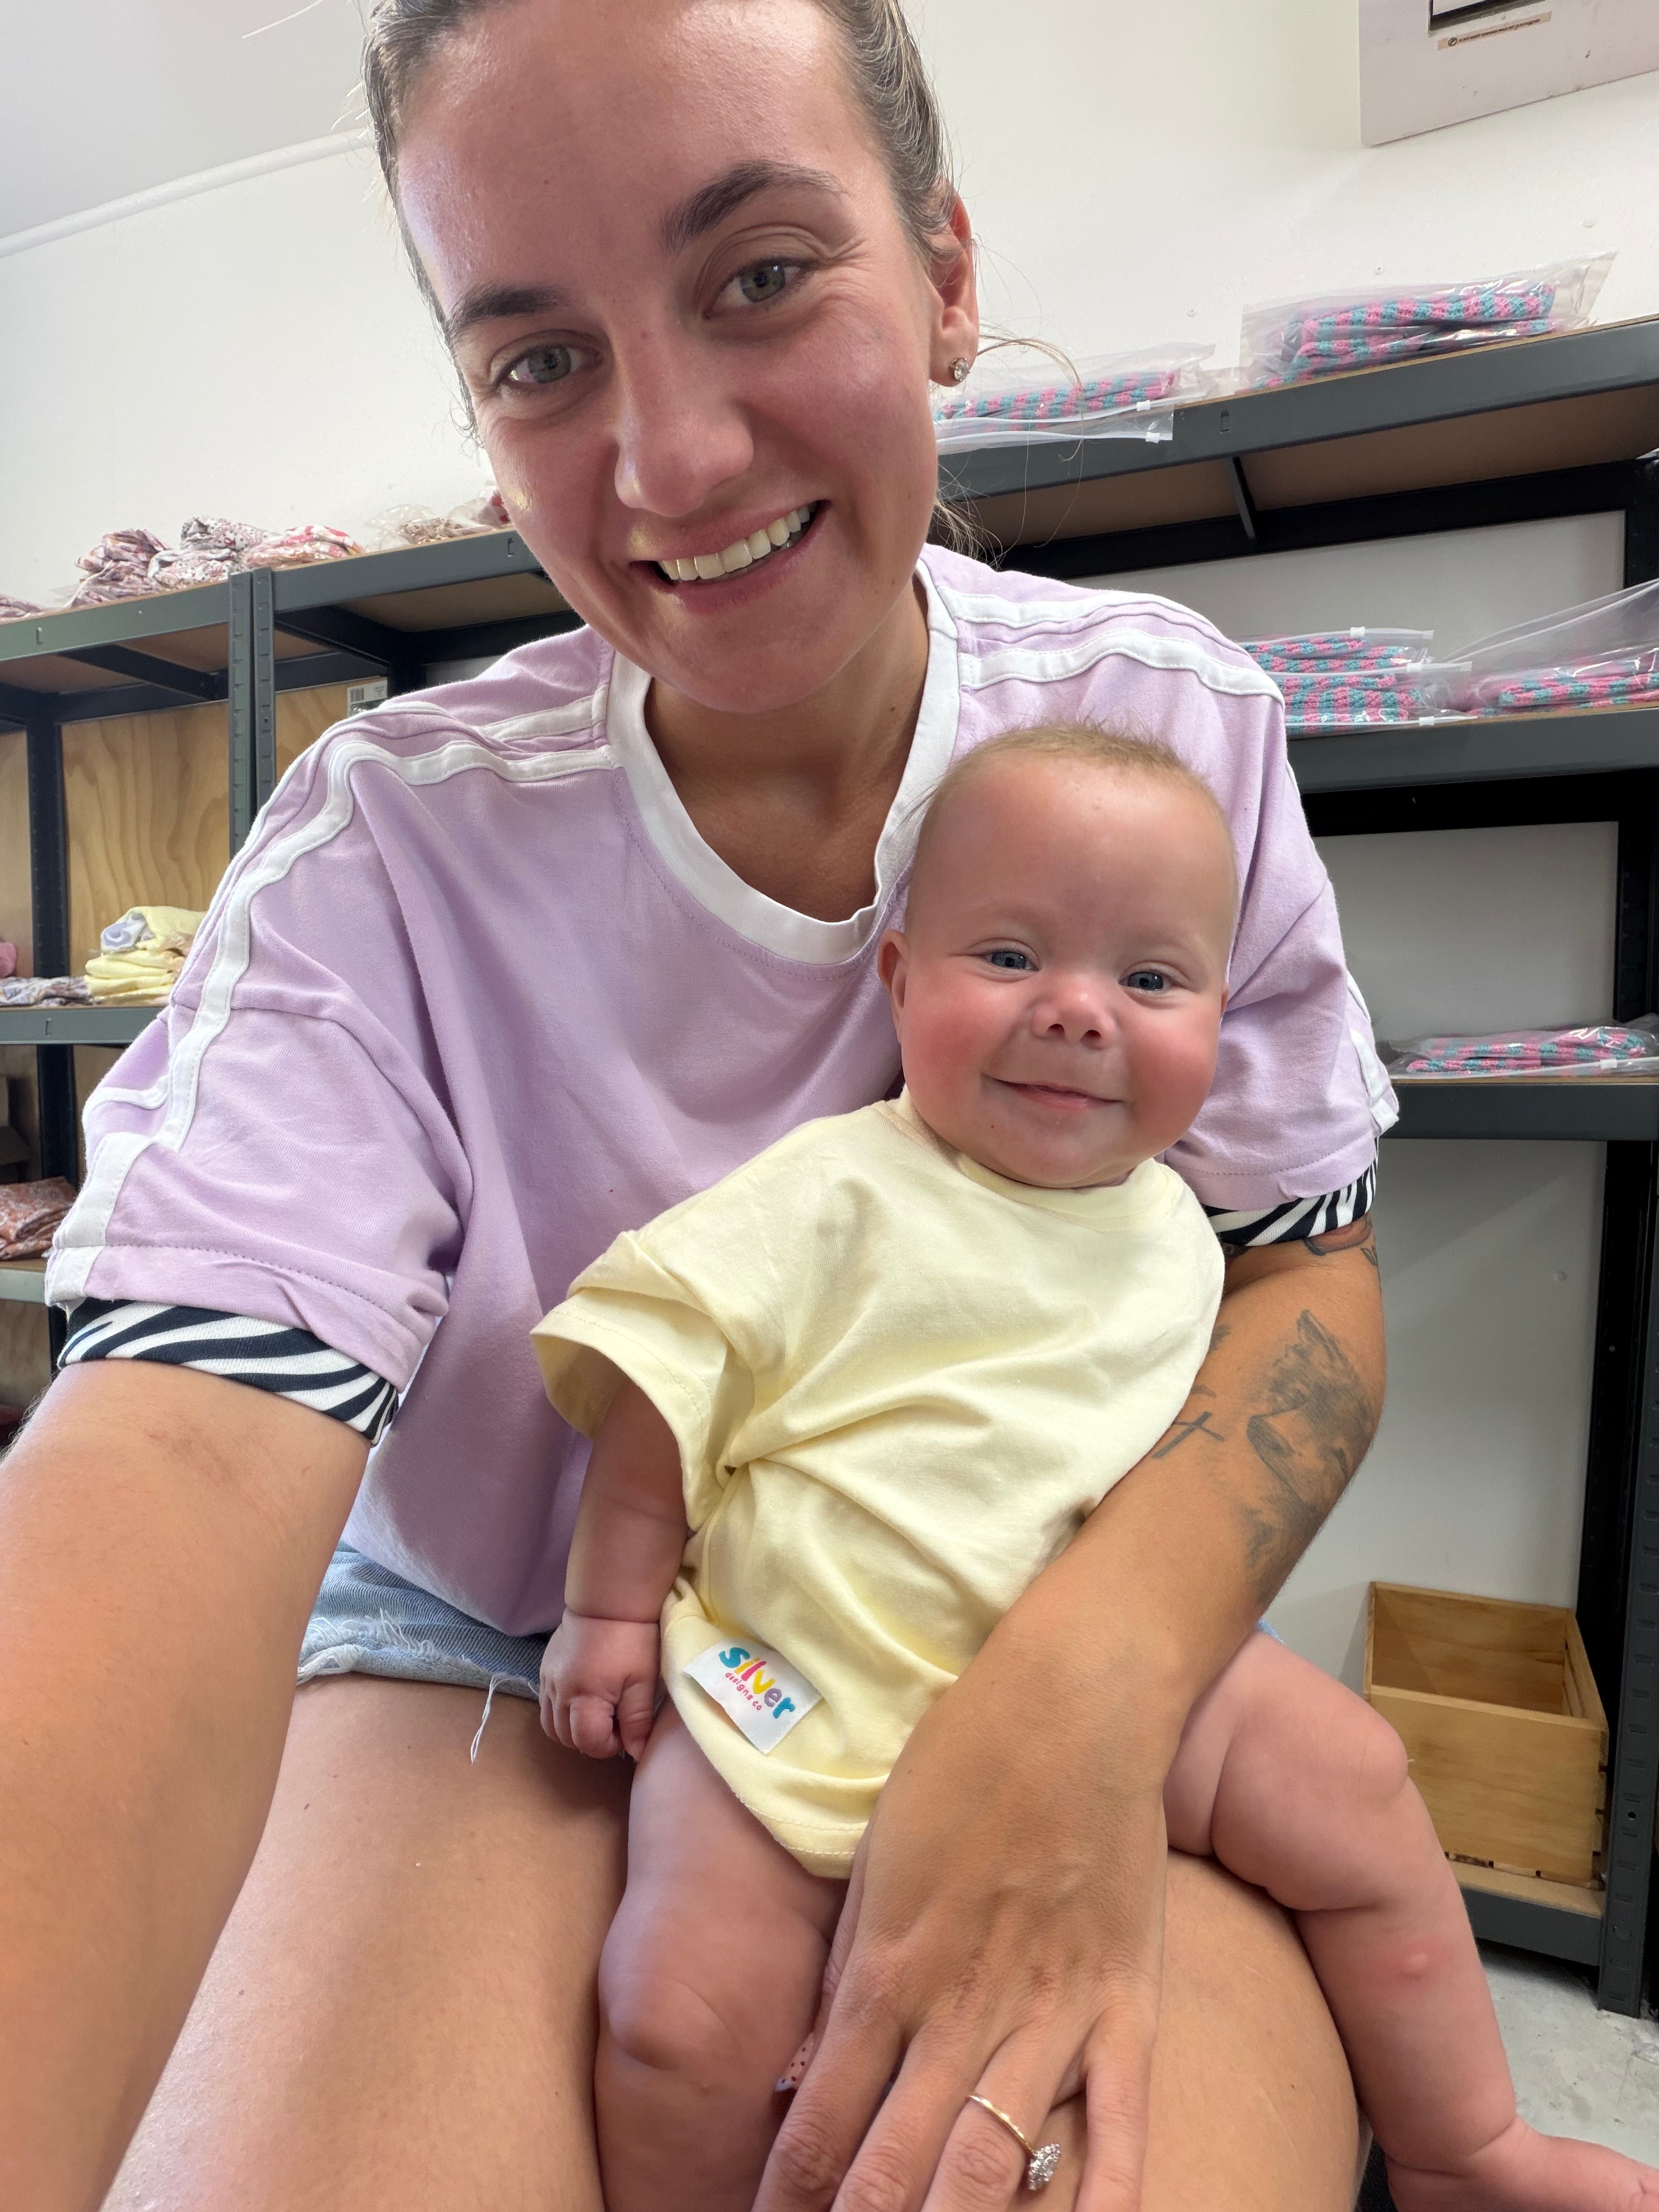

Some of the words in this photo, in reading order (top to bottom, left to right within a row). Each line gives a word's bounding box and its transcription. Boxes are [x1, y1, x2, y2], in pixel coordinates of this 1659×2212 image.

[719, 1647, 795, 1719] silver
[725, 1673, 753, 1700] designs
[752, 1701, 762, 1711] co
